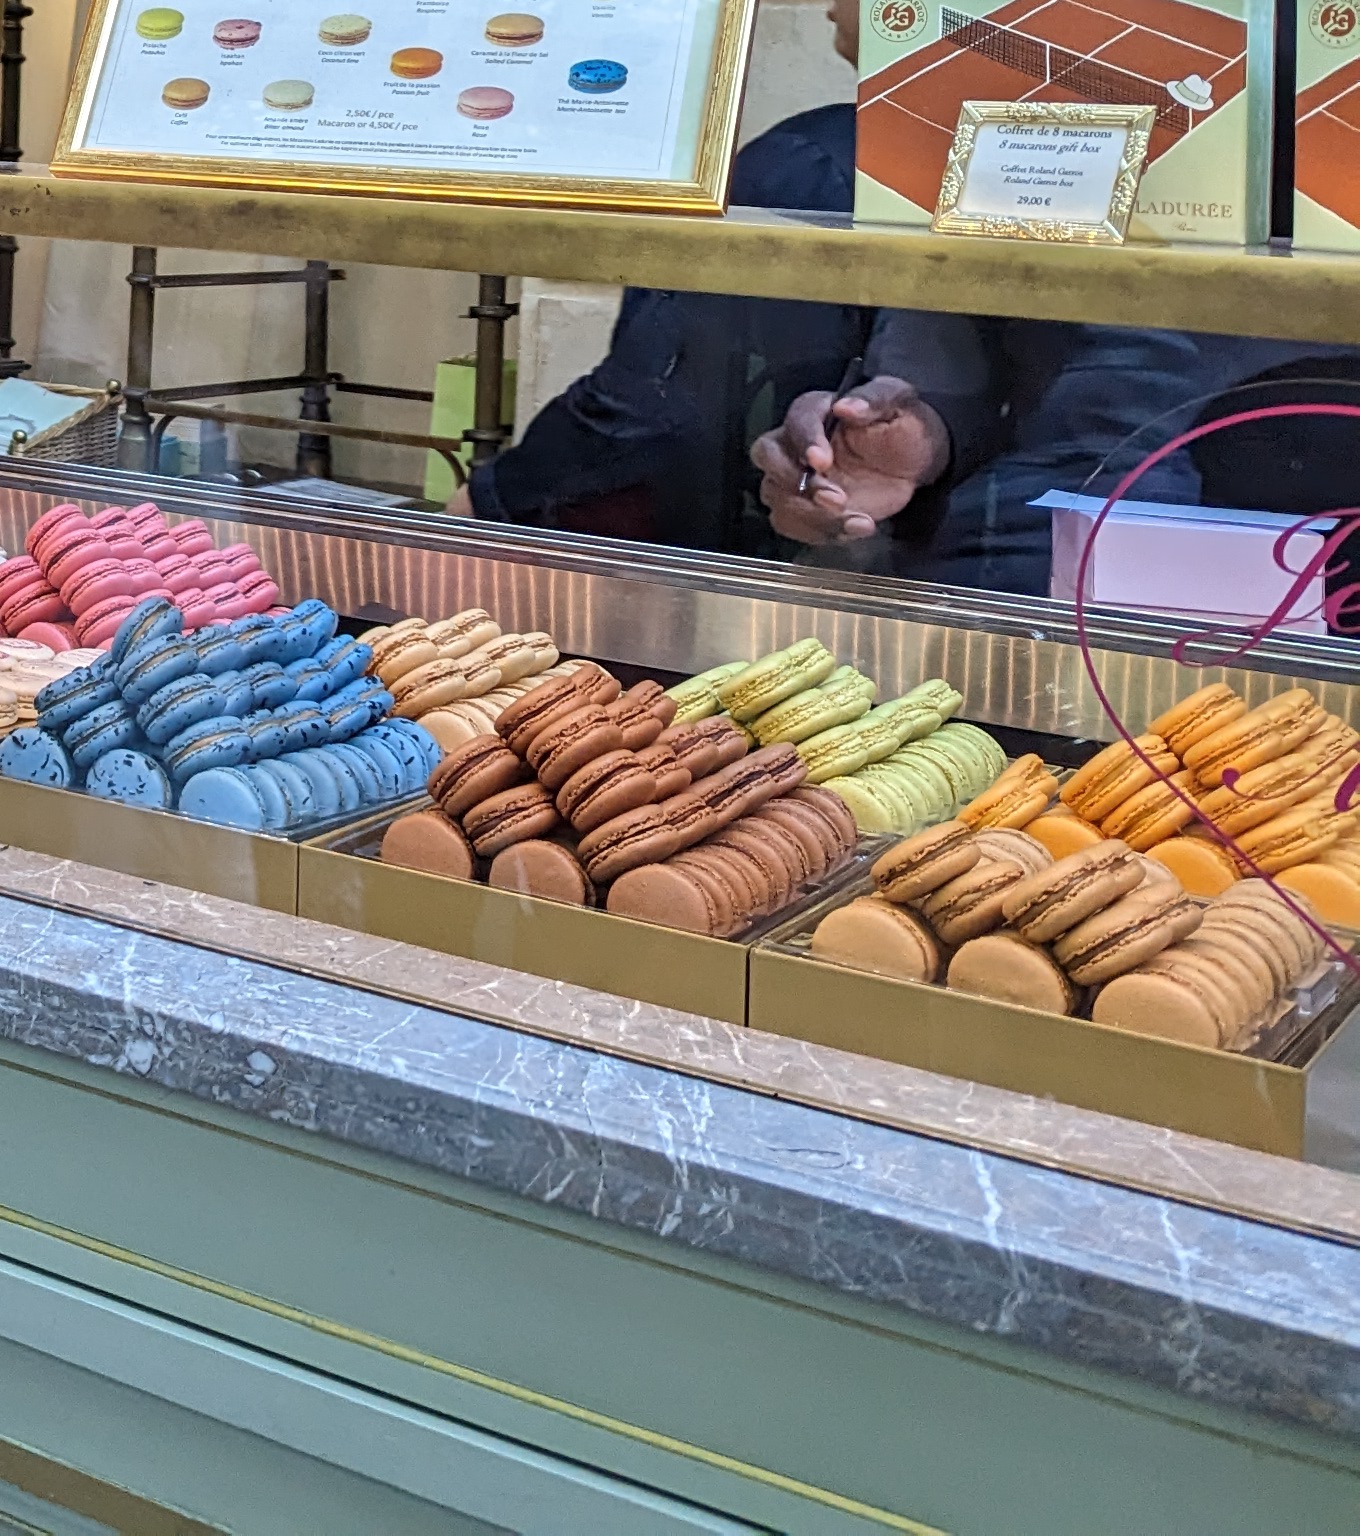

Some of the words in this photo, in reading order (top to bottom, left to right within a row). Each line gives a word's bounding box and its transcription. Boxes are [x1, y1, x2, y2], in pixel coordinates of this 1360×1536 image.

[345, 109, 371, 119] 2,50€
[378, 111, 395, 120] pce
[317, 120, 356, 128] Macaron
[368, 120, 395, 131] 4,50€
[401, 122, 419, 132] pce
[997, 124, 1034, 136] Coffret
[1036, 125, 1049, 136] de
[1052, 127, 1061, 137] 8
[1062, 129, 1113, 139] macarons
[998, 140, 1009, 150] 8
[1008, 142, 1057, 151] macarons
[1056, 142, 1079, 155] gift
[1080, 142, 1102, 153] box
[1000, 164, 1028, 174] Coffret
[1028, 166, 1056, 175] Roland
[1003, 175, 1032, 185] Roland
[1058, 178, 1075, 187] box
[1016, 195, 1043, 207] 29,00
[1044, 197, 1052, 206] €
[1134, 200, 1233, 218] LADURÉE
